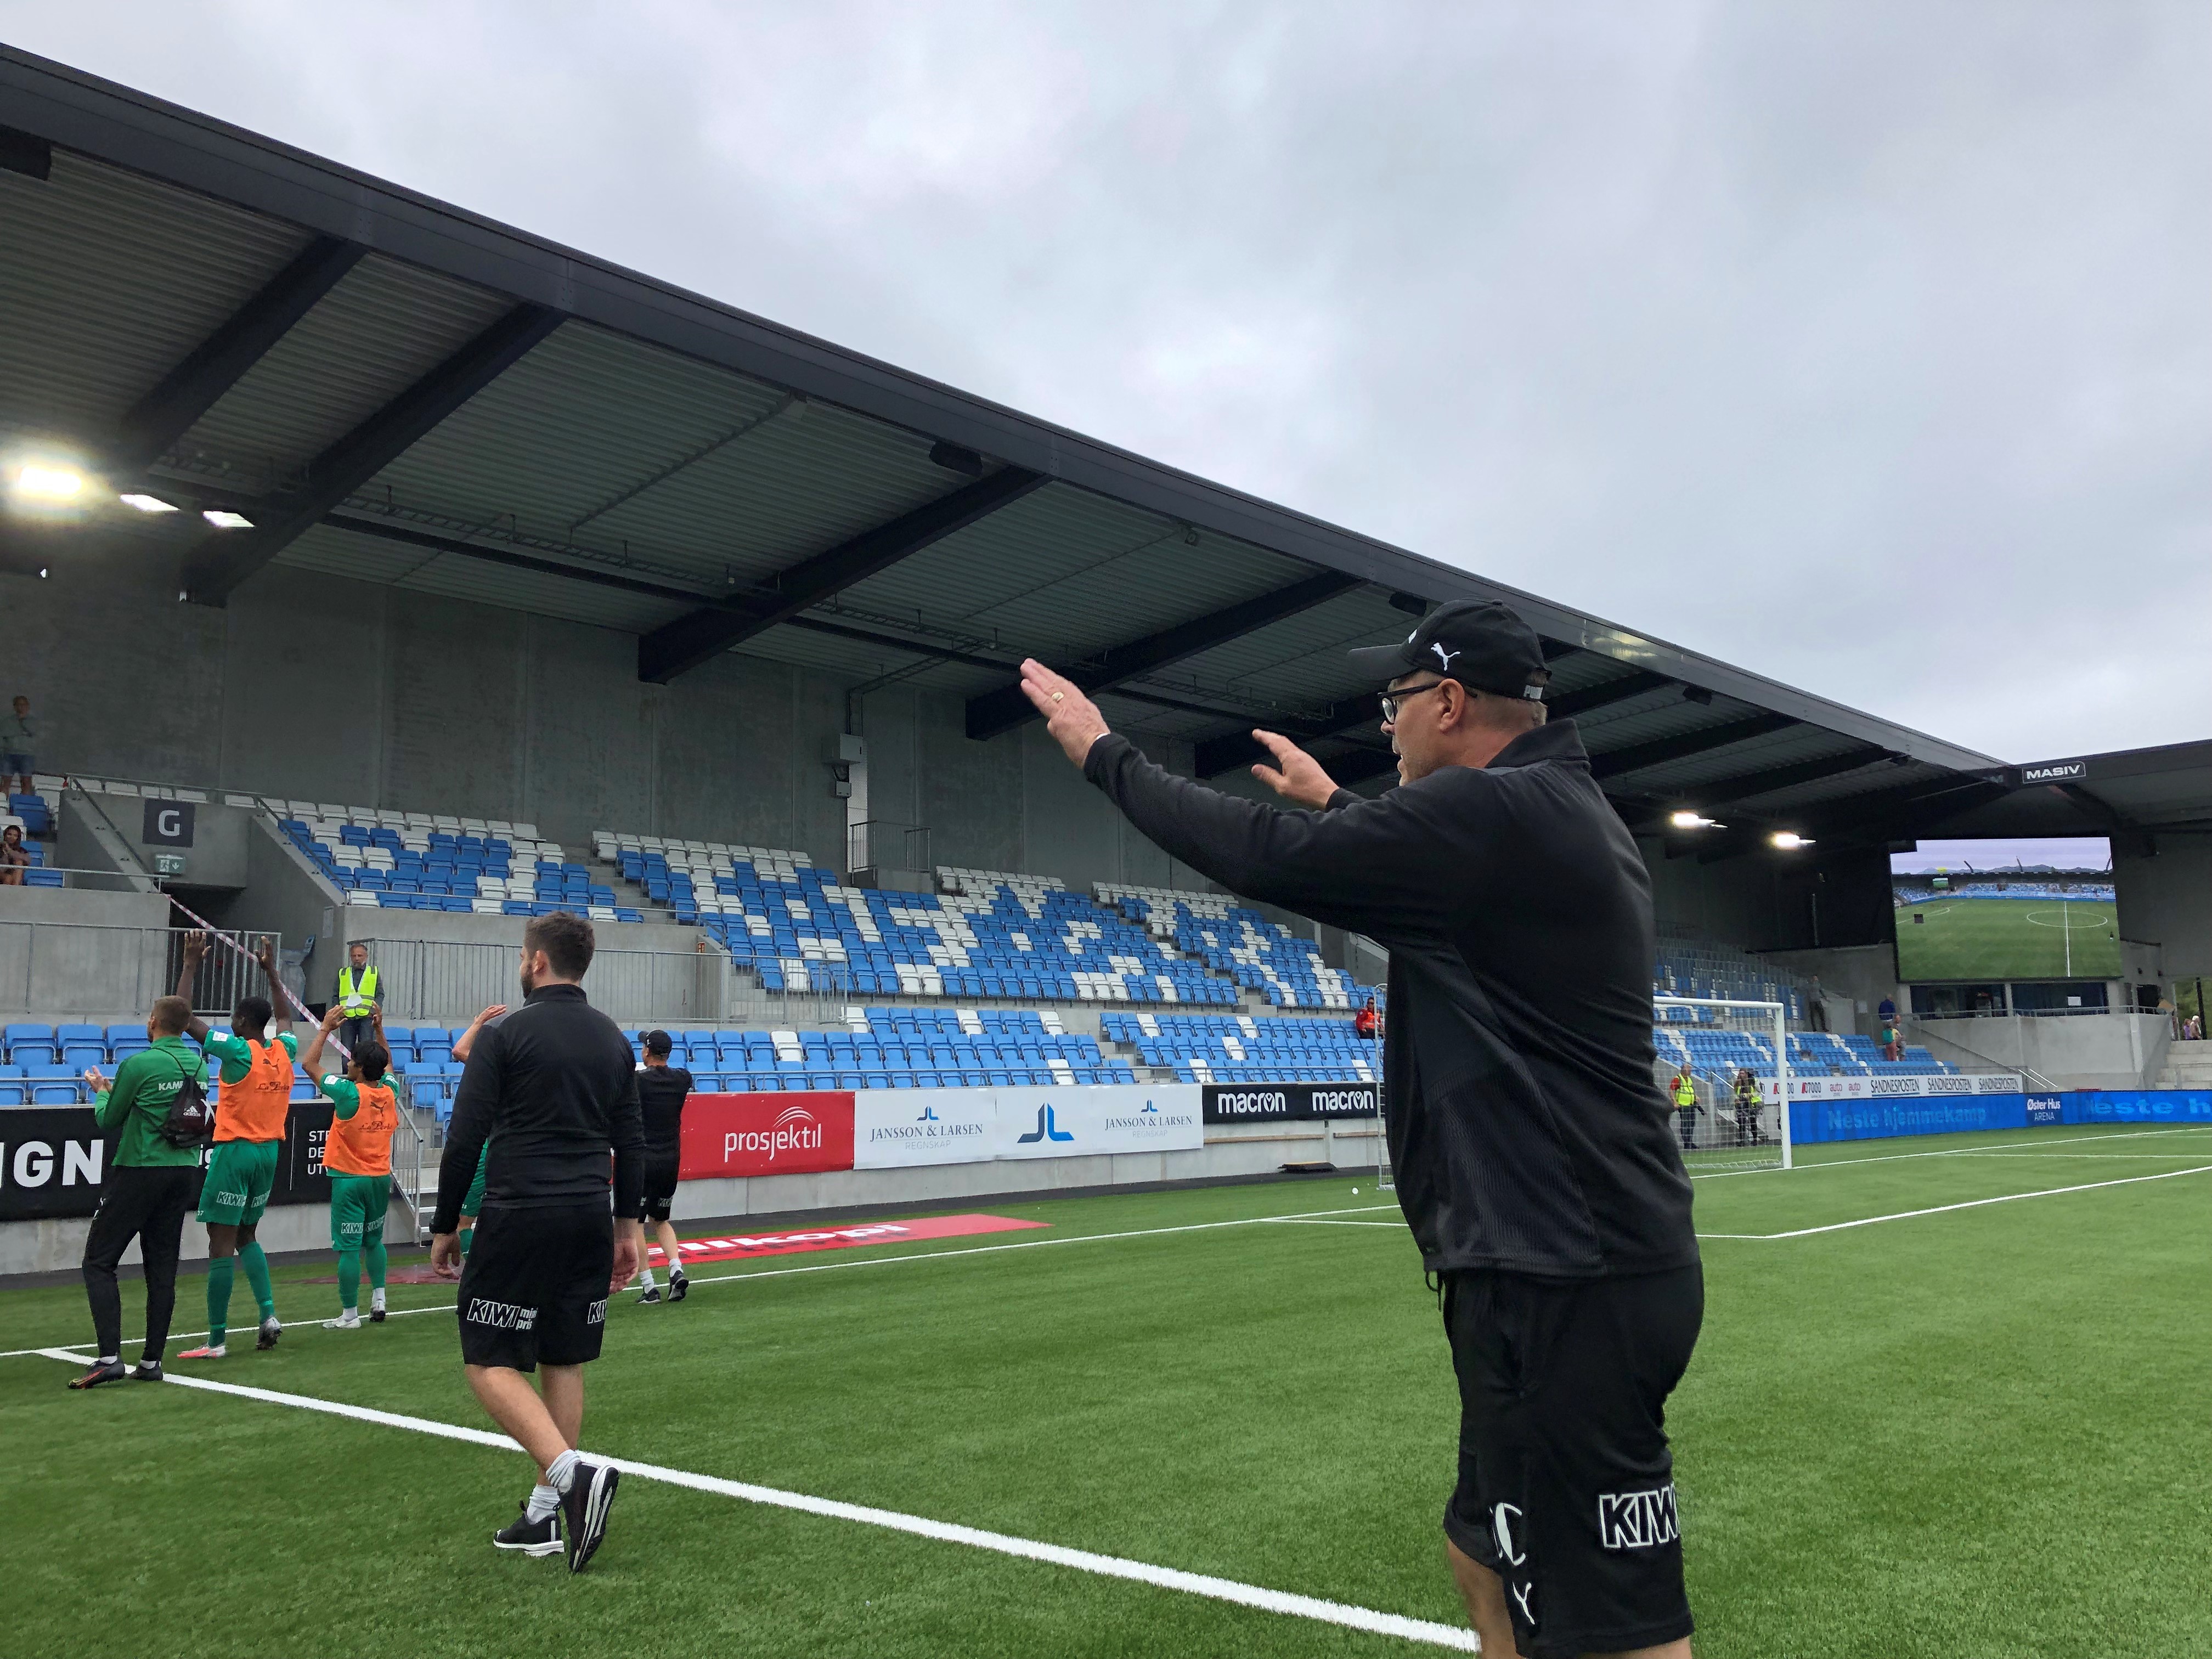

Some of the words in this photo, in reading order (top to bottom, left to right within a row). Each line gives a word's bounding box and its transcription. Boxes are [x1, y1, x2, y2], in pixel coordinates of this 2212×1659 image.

[2026, 765, 2080, 780] MASIV
[158, 810, 180, 837] G
[1870, 1078, 1920, 1093] SANDNESPOSTEN
[1927, 1077, 1972, 1091] SANDNESPOSTEN
[1979, 1077, 2019, 1090] SANDNESPOSTEN
[1217, 1092, 1286, 1114] macron
[1312, 1090, 1374, 1111] macron
[2027, 1098, 2047, 1111] Øster
[2047, 1097, 2061, 1110] Hus
[1104, 1116, 1146, 1131] JANSSON
[1148, 1116, 1156, 1126] &
[1159, 1115, 1193, 1126] LARSEN
[1827, 1109, 1880, 1130] Neste
[1883, 1106, 1987, 1130] hjemmekamp
[2034, 1111, 2055, 1121] ARENA
[870, 1126, 923, 1143] JANSSON
[927, 1125, 937, 1137] &
[940, 1124, 983, 1137] LARSEN
[1132, 1129, 1169, 1138] REGNSKAP
[724, 1122, 822, 1164] prosjektil
[905, 1139, 951, 1150] REGNSKAP
[466, 1297, 521, 1328] KIWI
[515, 1318, 533, 1330] pris
[1599, 1481, 1680, 1548] KIW
